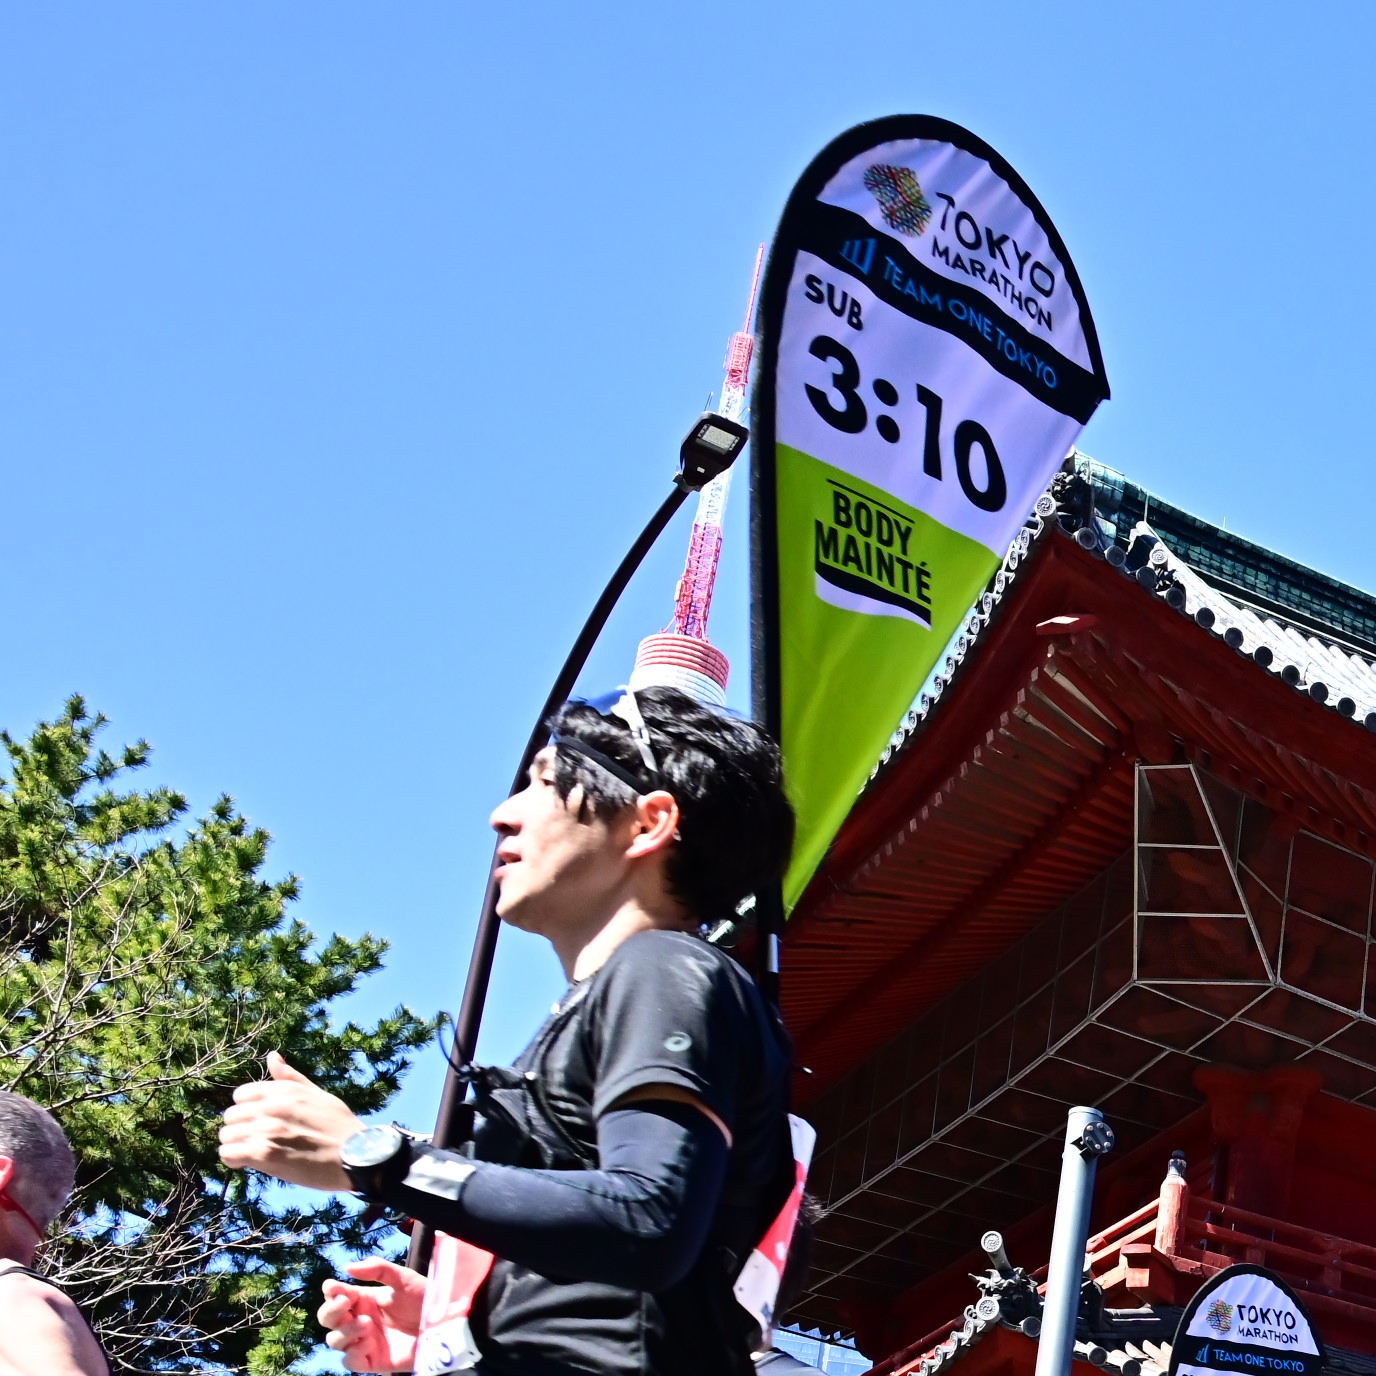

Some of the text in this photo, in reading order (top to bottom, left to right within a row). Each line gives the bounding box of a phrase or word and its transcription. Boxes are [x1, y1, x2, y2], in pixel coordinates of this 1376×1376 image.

[936, 191, 1056, 298] TOKYO
[804, 274, 864, 332] SUB
[884, 256, 944, 314] TEAM
[932, 235, 1053, 332] MARATHON
[804, 335, 1008, 513] 3:10
[832, 490, 915, 552] BODY
[815, 519, 932, 605] MAINTÉ
[1237, 1304, 1296, 1330] TOKYO
[1237, 1325, 1298, 1345] MARATHON
[1213, 1349, 1305, 1373] TEAM ONE TOKYO
